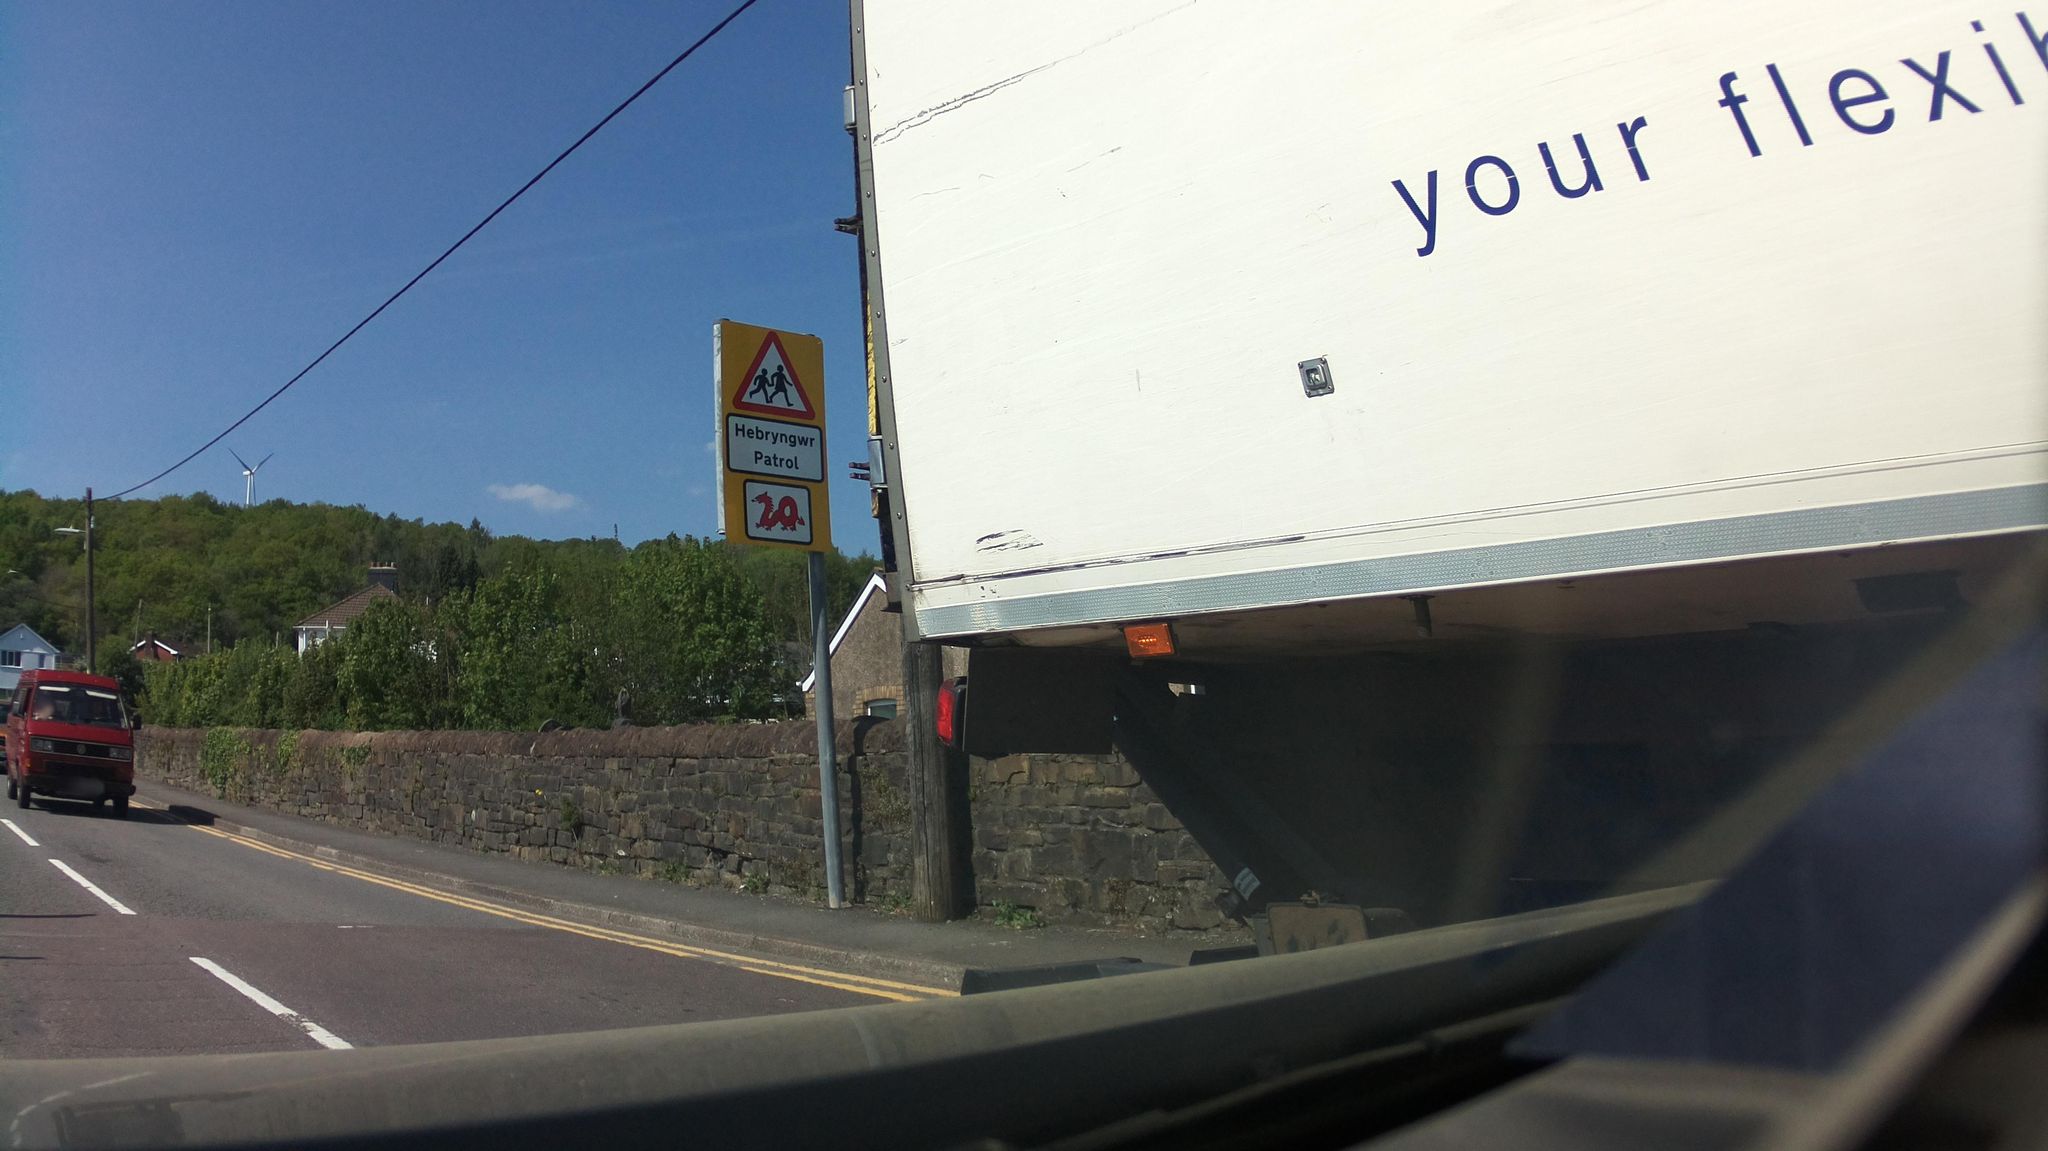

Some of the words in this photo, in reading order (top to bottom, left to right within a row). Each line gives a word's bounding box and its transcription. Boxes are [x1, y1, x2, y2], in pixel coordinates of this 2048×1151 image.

[1390, 115, 1651, 257] your
[735, 422, 815, 448] Hebryngwr
[754, 450, 800, 470] Patrol
